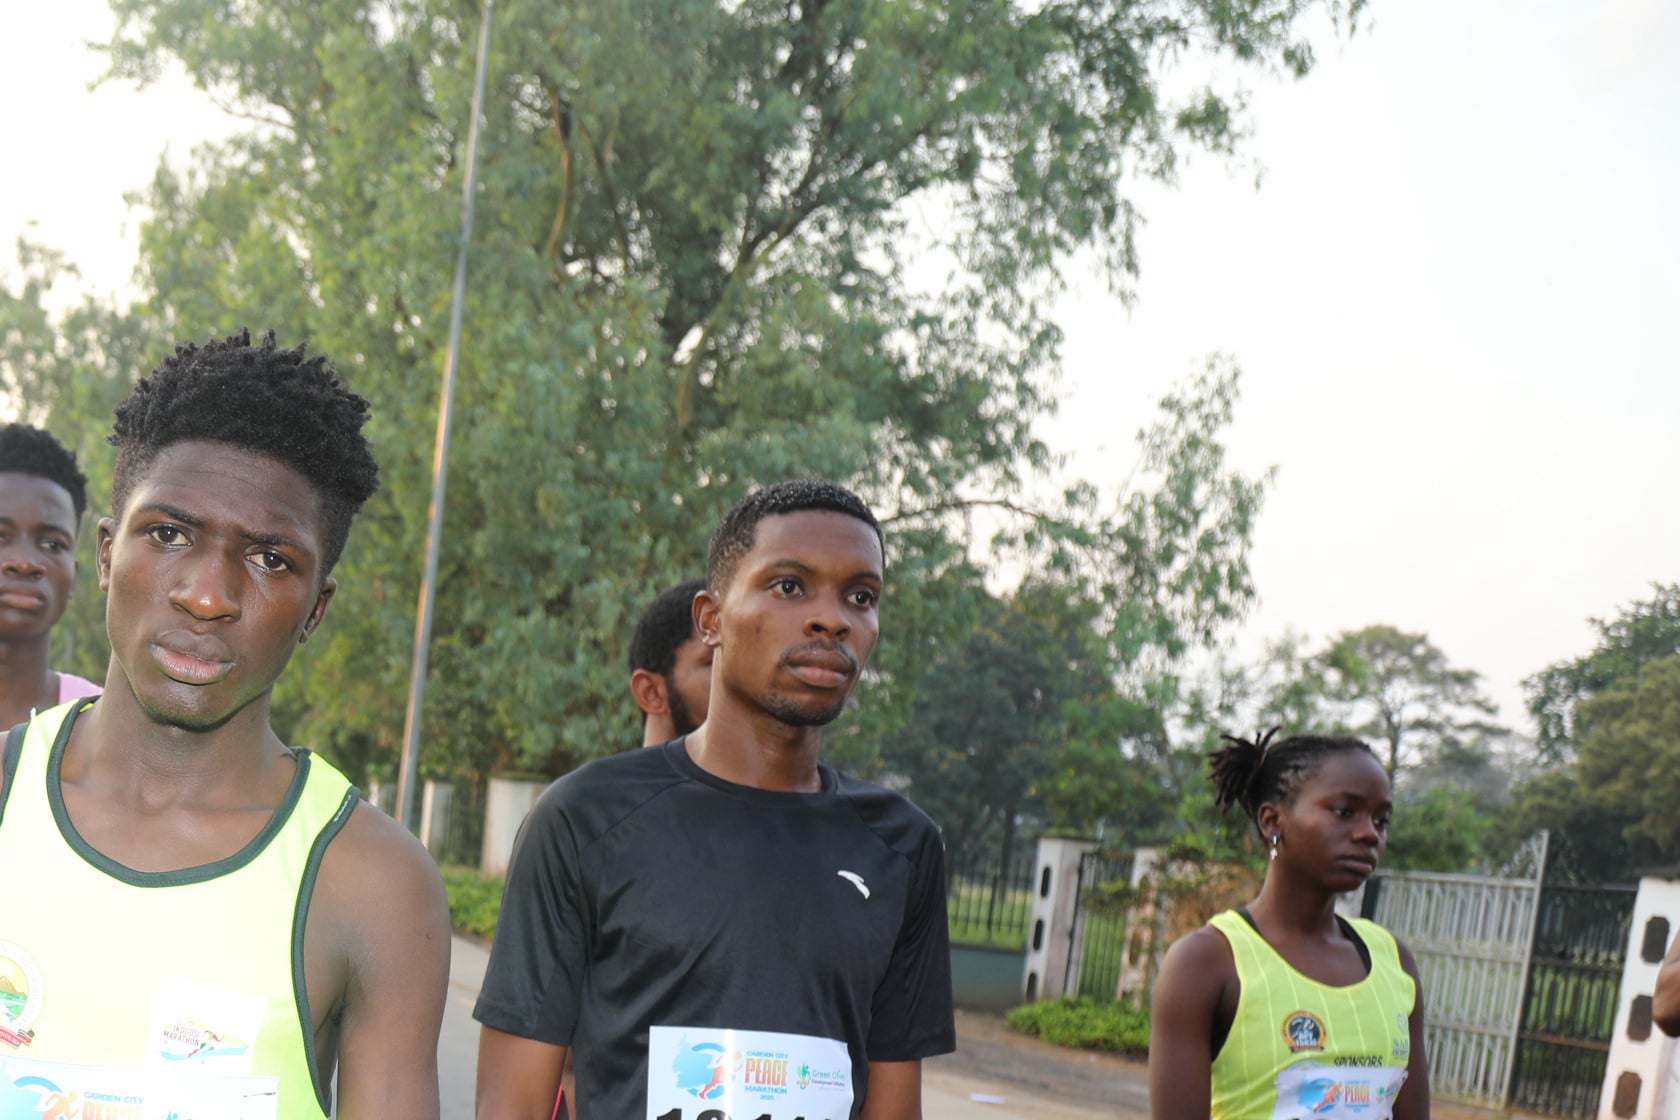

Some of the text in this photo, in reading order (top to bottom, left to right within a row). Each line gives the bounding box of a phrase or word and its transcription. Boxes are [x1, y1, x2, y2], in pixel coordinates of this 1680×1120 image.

[163, 1030, 200, 1046] MARATHON
[1333, 1056, 1383, 1068] SPONSORS
[745, 1057, 789, 1086] PEACE
[745, 1085, 787, 1095] MARATHON
[83, 1091, 144, 1104] GARDEN CITY
